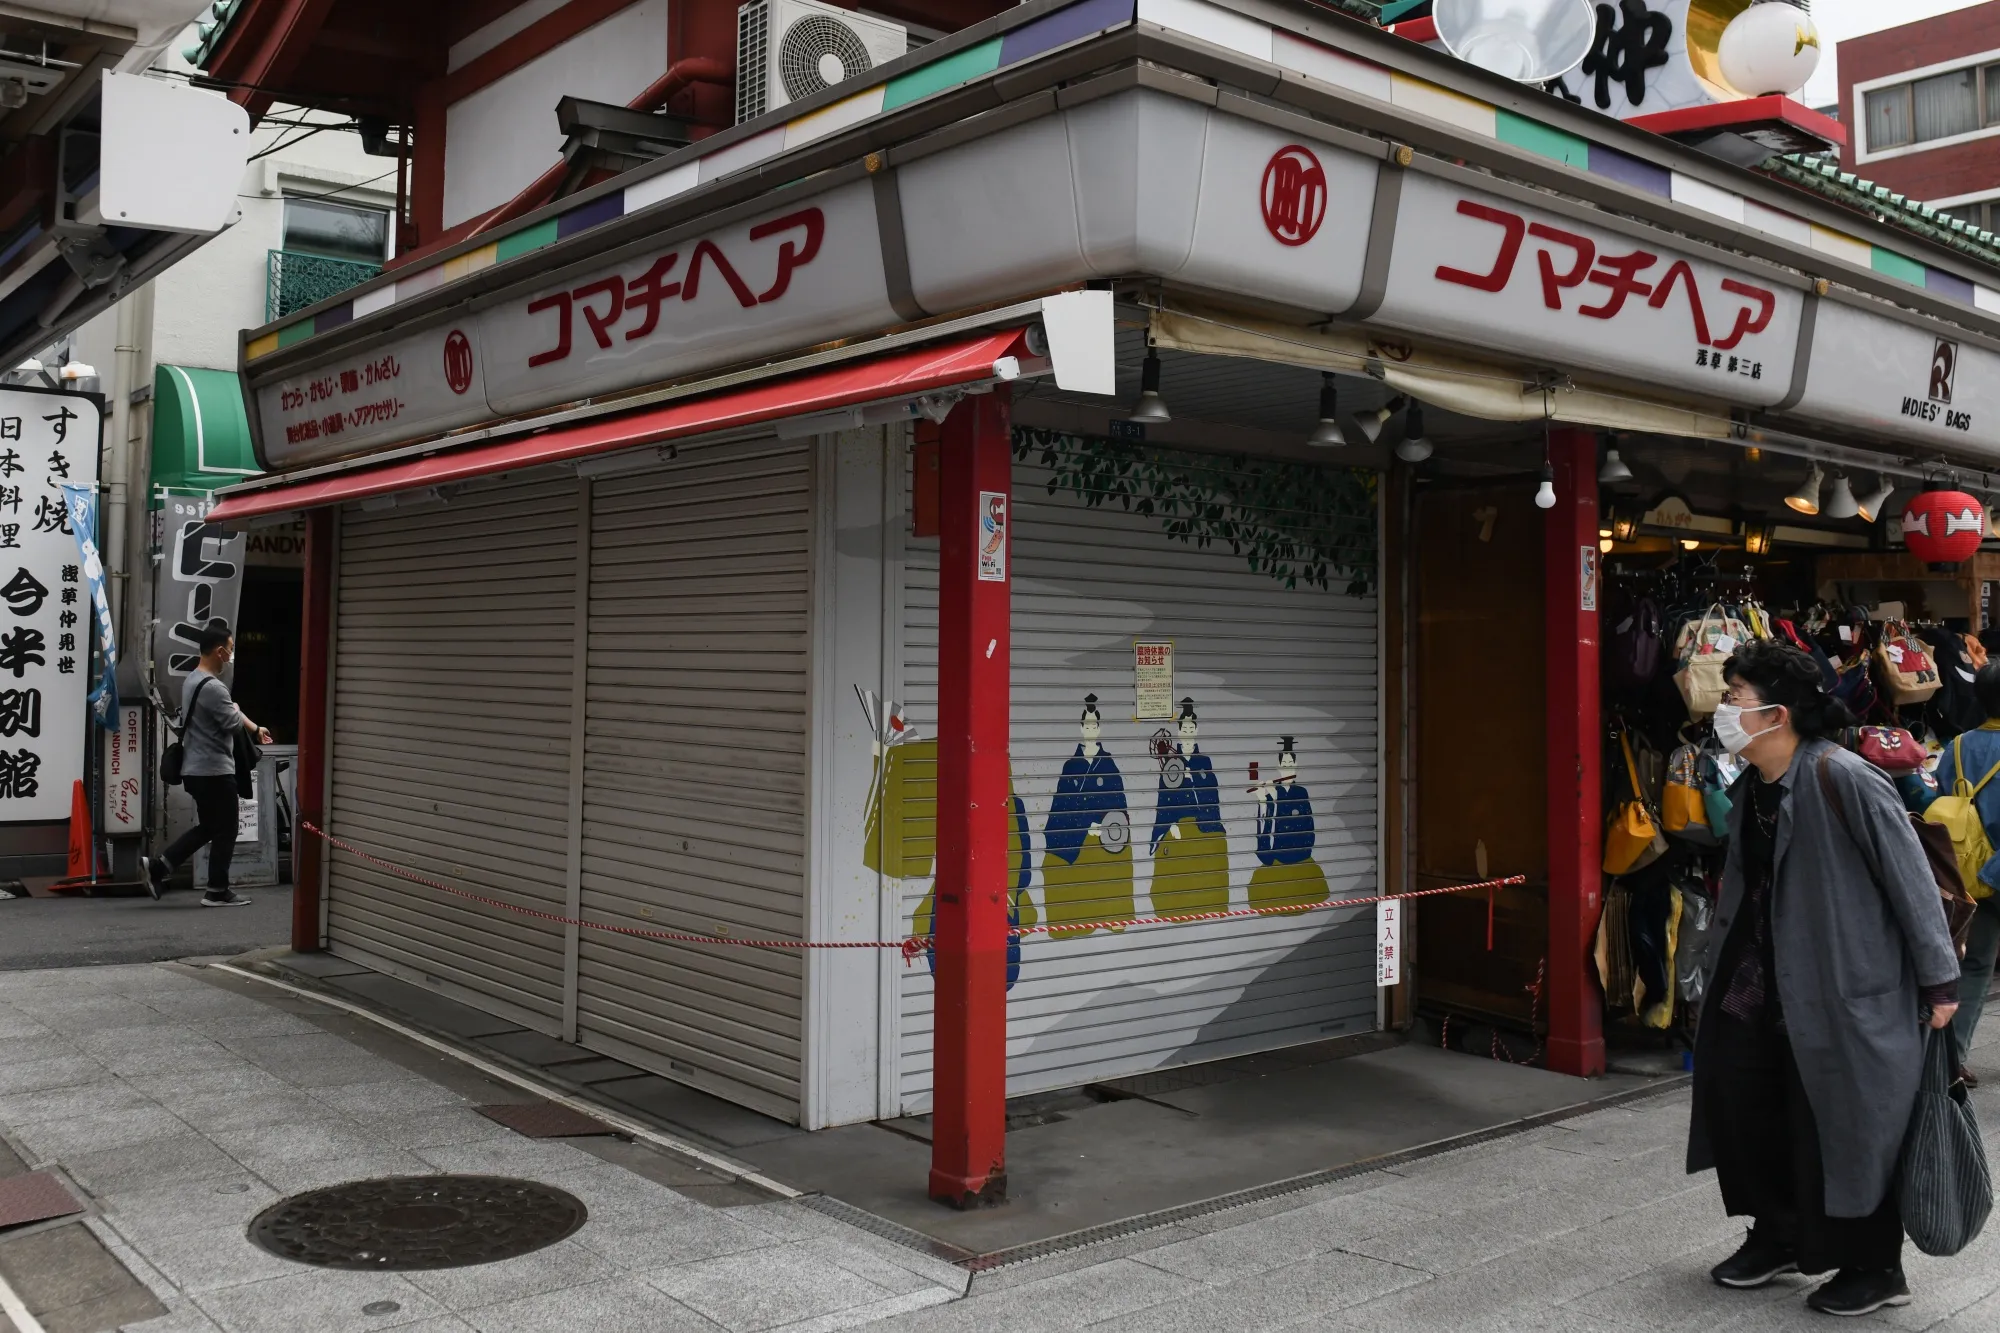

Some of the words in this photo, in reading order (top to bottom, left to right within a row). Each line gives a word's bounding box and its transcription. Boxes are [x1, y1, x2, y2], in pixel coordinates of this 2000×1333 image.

[527, 206, 825, 368] コマチヘア
[1435, 200, 1776, 350] コマチヘア
[1696, 349, 1722, 369] 浅草
[1728, 356, 1762, 380] 第三店
[1945, 409, 1972, 431] BAGS
[32, 405, 78, 536] すき焼
[57, 564, 79, 675] 浅草仲見世
[0, 566, 49, 799] 今半別館
[1137, 656, 1164, 665] お知らせ
[111, 729, 120, 775] ANDWICH
[127, 710, 137, 753] COFFEE
[116, 777, 139, 825] Candy
[1384, 907, 1394, 979] 立入禁止
